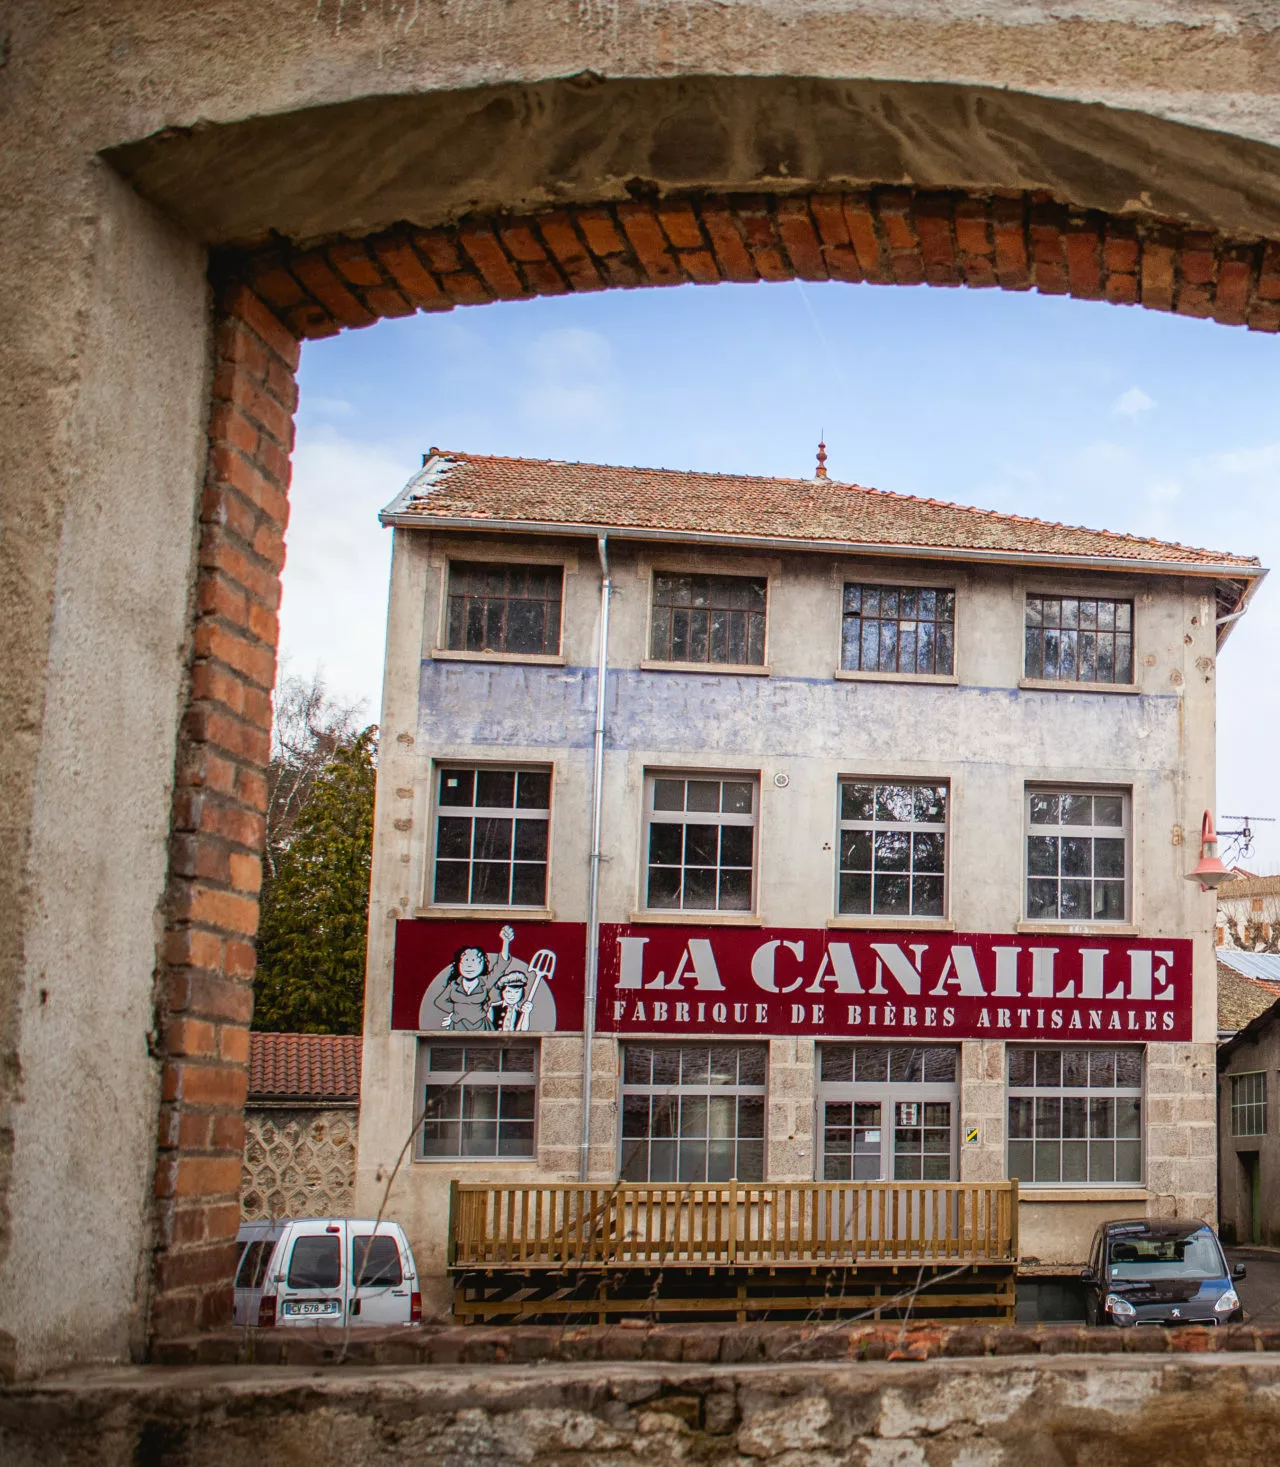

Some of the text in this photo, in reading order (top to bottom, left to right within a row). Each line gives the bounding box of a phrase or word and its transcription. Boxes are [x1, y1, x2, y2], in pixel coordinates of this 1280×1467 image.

[614, 936, 1175, 1001] LA CANAILLE
[613, 1000, 1175, 1031] FABRIQUE DE BIÈRES ARTISANALES
